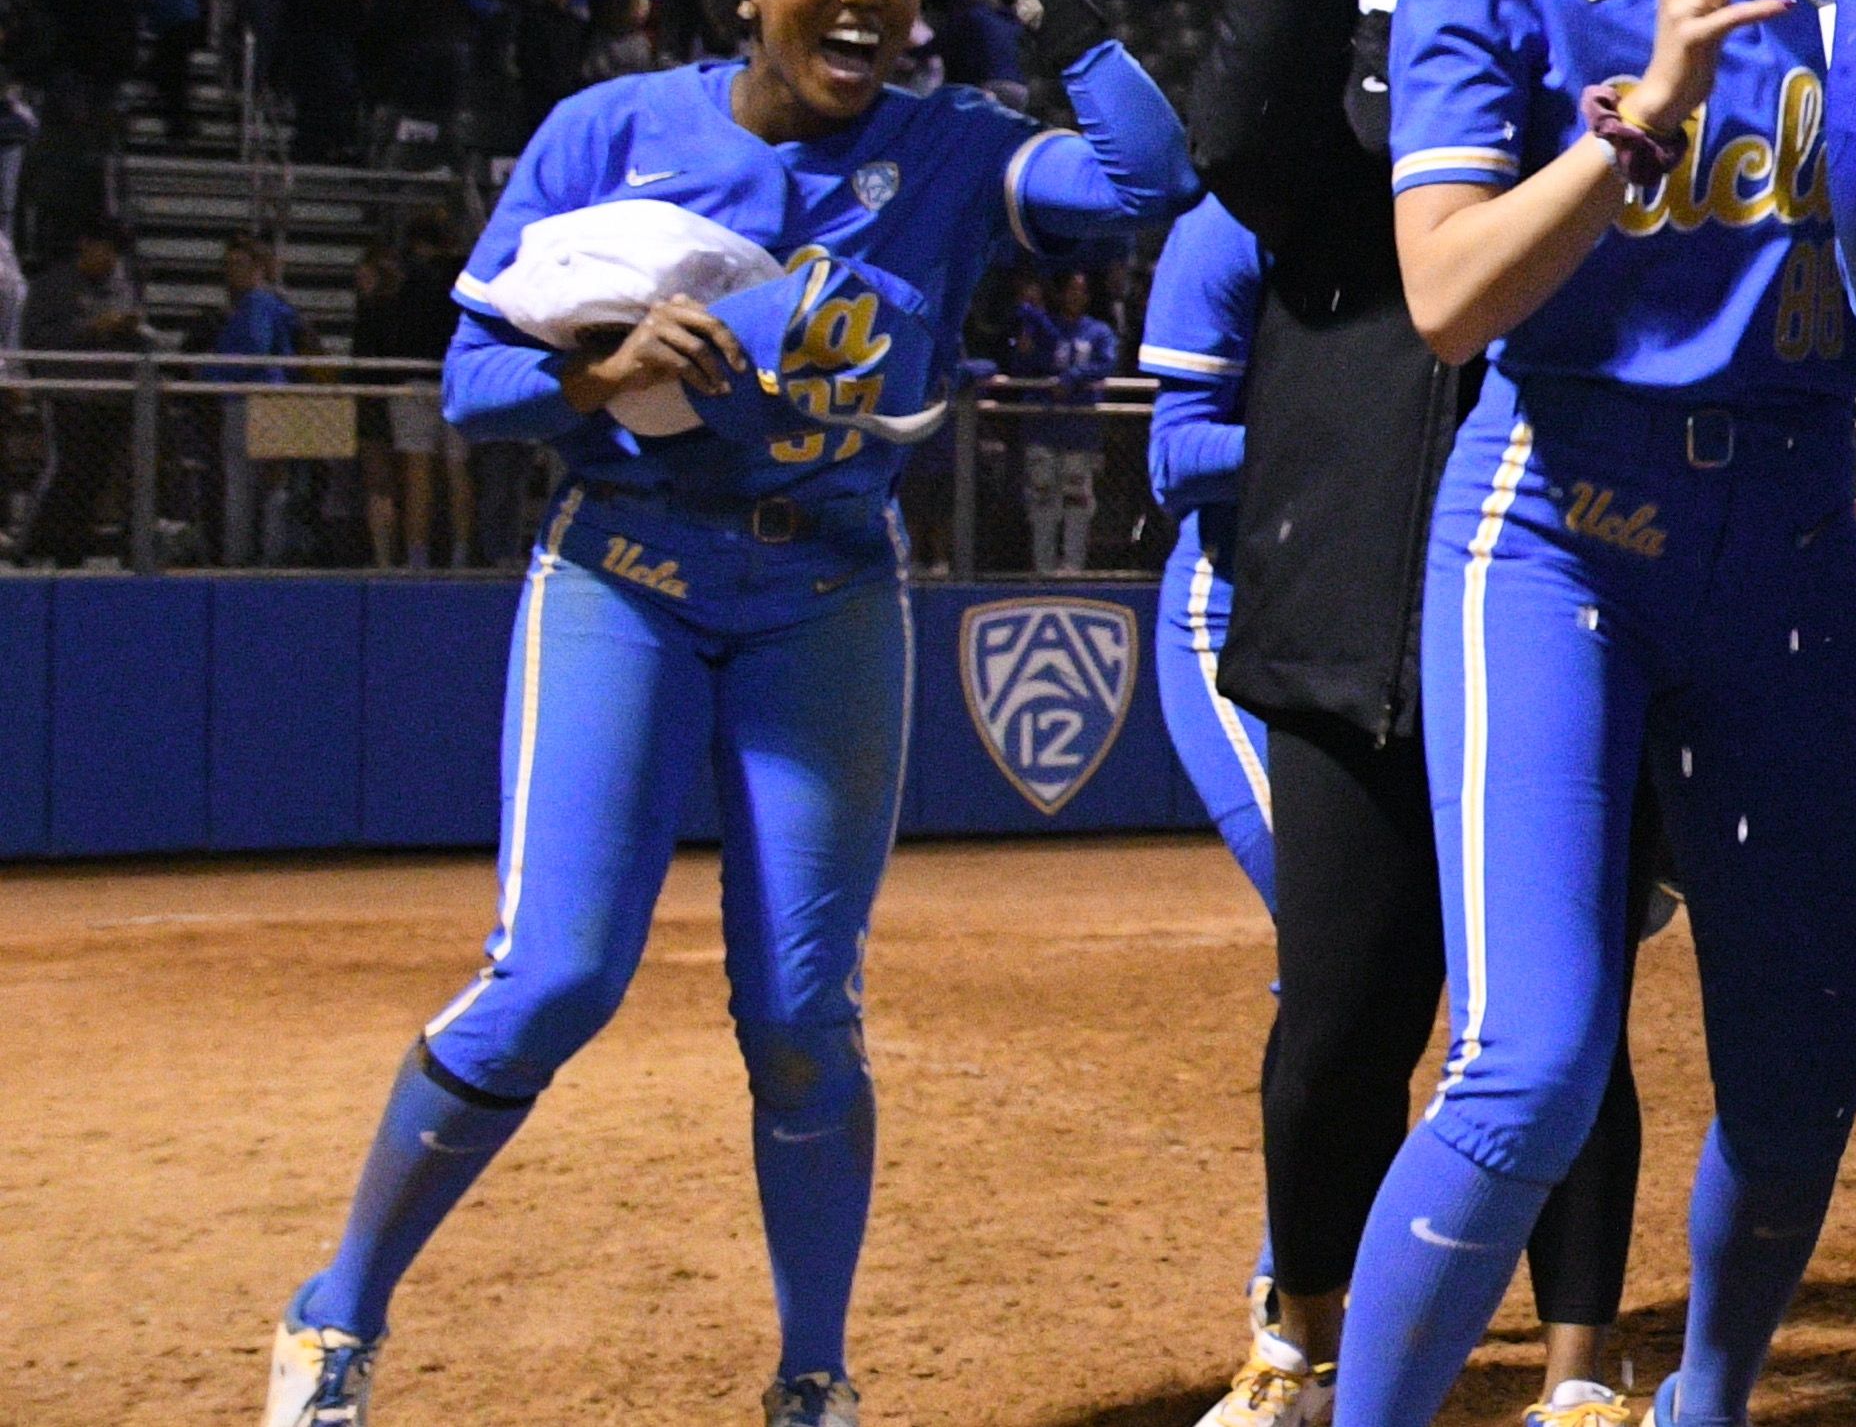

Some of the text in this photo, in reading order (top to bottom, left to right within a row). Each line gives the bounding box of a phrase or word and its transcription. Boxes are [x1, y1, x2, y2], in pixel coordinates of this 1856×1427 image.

[1598, 65, 1834, 237] Ucl
[782, 243, 892, 374] la
[1565, 481, 1666, 557] Ucla
[603, 536, 688, 599] Ucla
[974, 610, 1124, 722] PAC
[1019, 708, 1084, 769] 12
